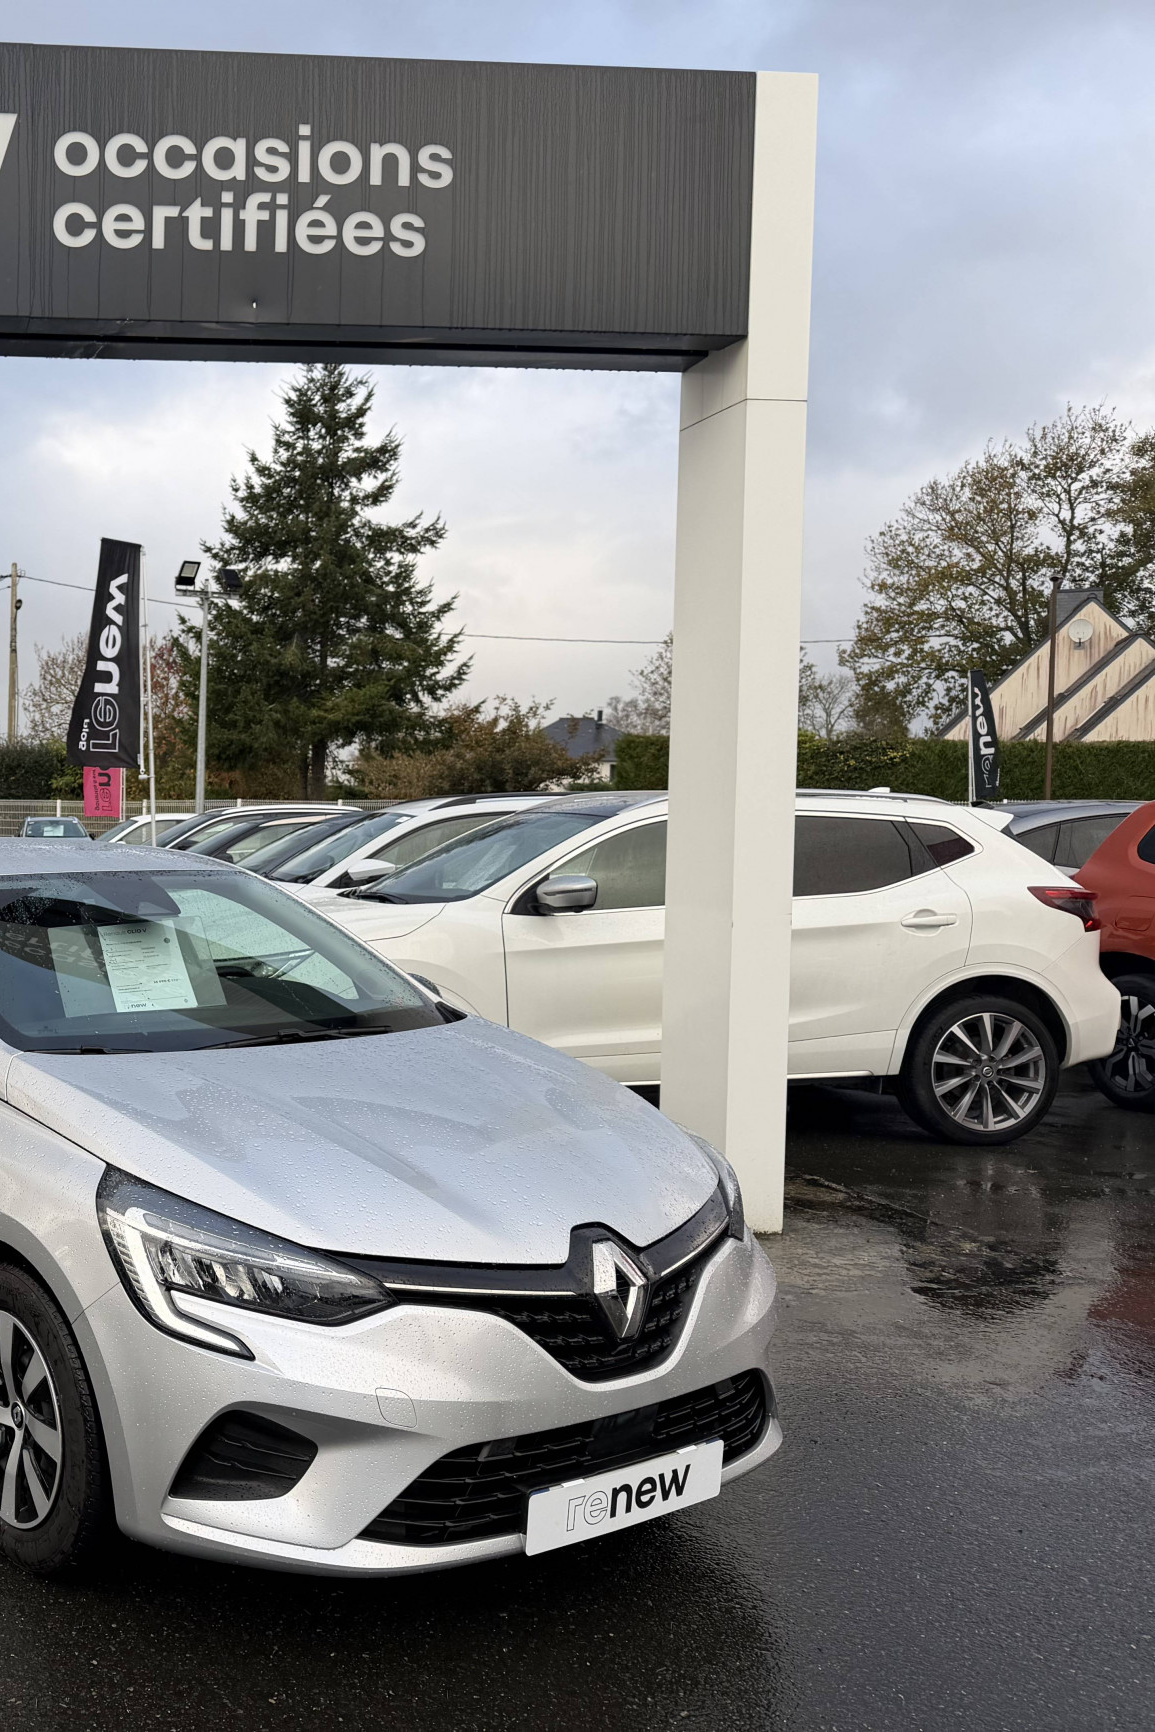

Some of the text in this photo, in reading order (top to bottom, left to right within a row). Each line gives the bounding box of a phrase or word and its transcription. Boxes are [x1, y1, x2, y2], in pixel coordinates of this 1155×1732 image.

[53, 123, 454, 189] occasions
[52, 191, 427, 258] certifiées
[565, 1463, 692, 1533] renew
